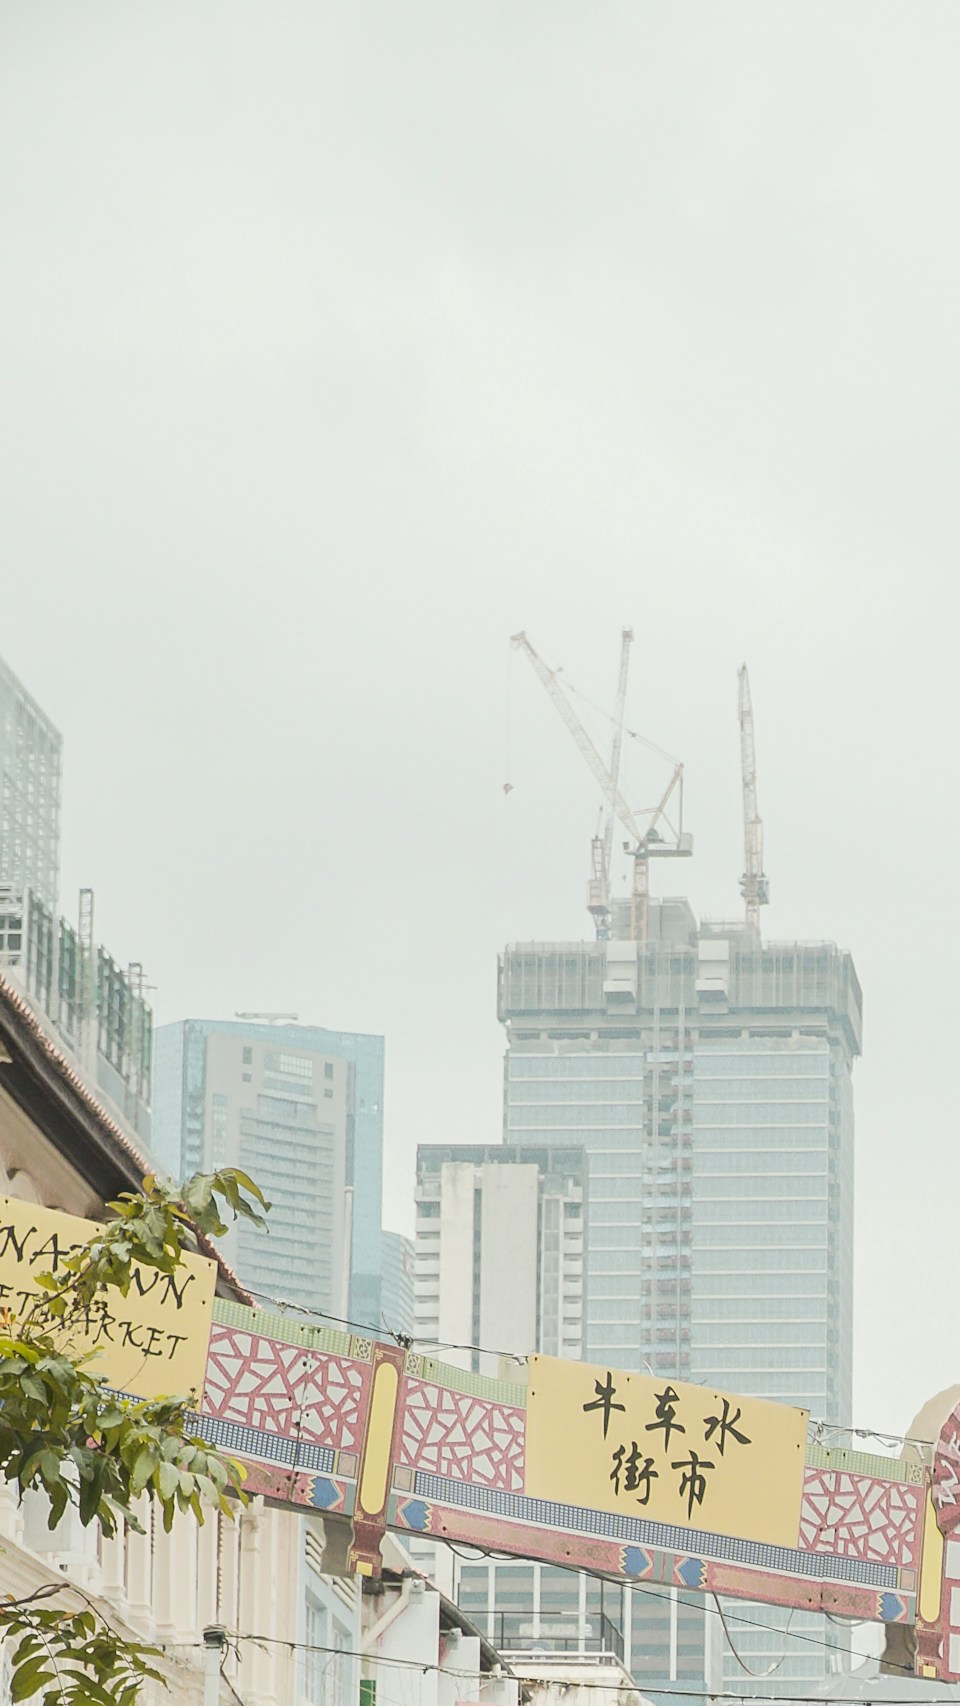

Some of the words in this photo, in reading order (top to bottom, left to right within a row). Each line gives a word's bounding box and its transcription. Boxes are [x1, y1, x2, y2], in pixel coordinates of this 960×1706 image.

[583, 1371, 752, 1457] 牛车水
[610, 1441, 715, 1521] 街市
